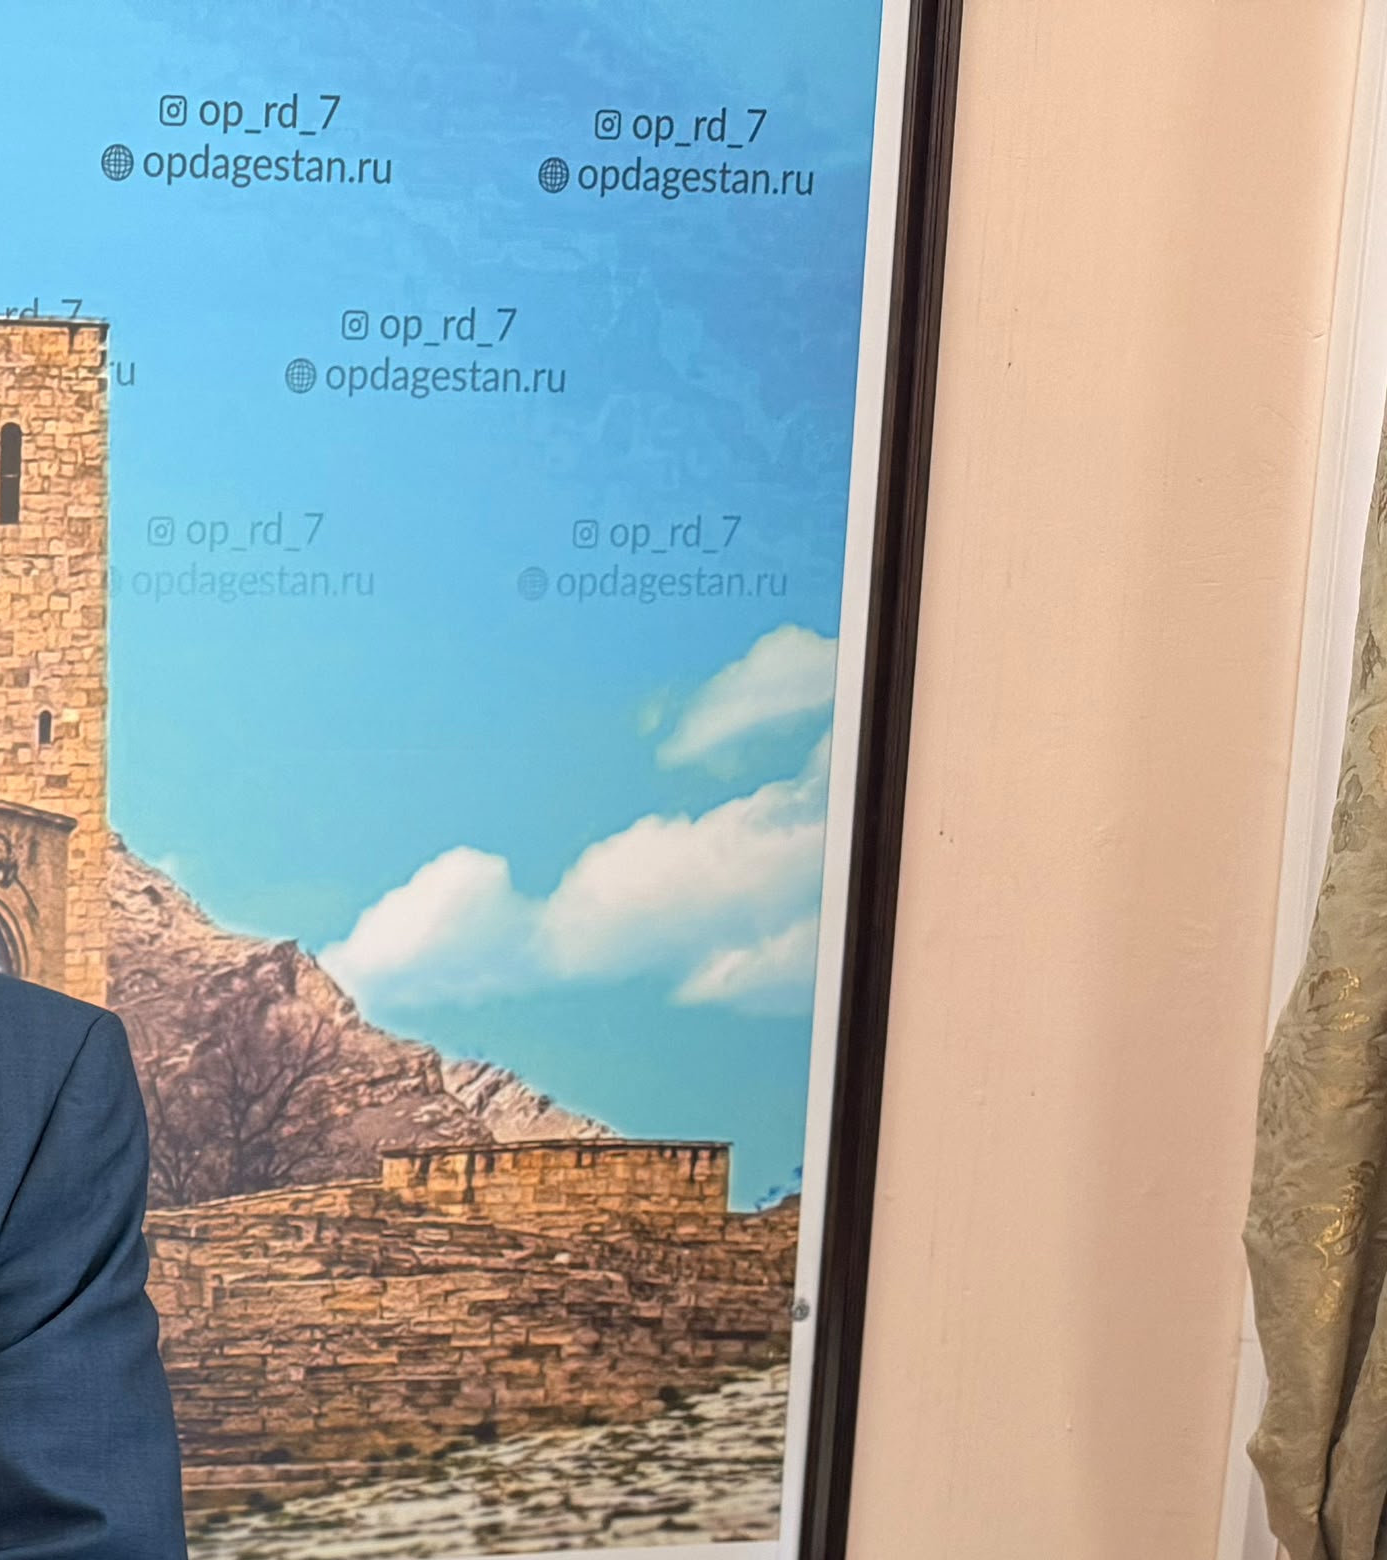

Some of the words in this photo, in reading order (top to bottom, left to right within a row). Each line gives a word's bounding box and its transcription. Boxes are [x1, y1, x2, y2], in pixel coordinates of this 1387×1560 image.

[199, 93, 341, 136] op_rd_7
[633, 108, 768, 149] op_rd_7
[143, 143, 392, 188] opdagestan.ru
[578, 156, 815, 200] opdagestan.ru
[379, 307, 518, 348] op_rd_7
[326, 357, 566, 399] opdagestan.ru
[187, 511, 325, 552] op_rd_7
[610, 515, 742, 554] op_rd_7
[131, 561, 375, 603] opdagestan.ru
[557, 565, 788, 604] opdagestan.ru
